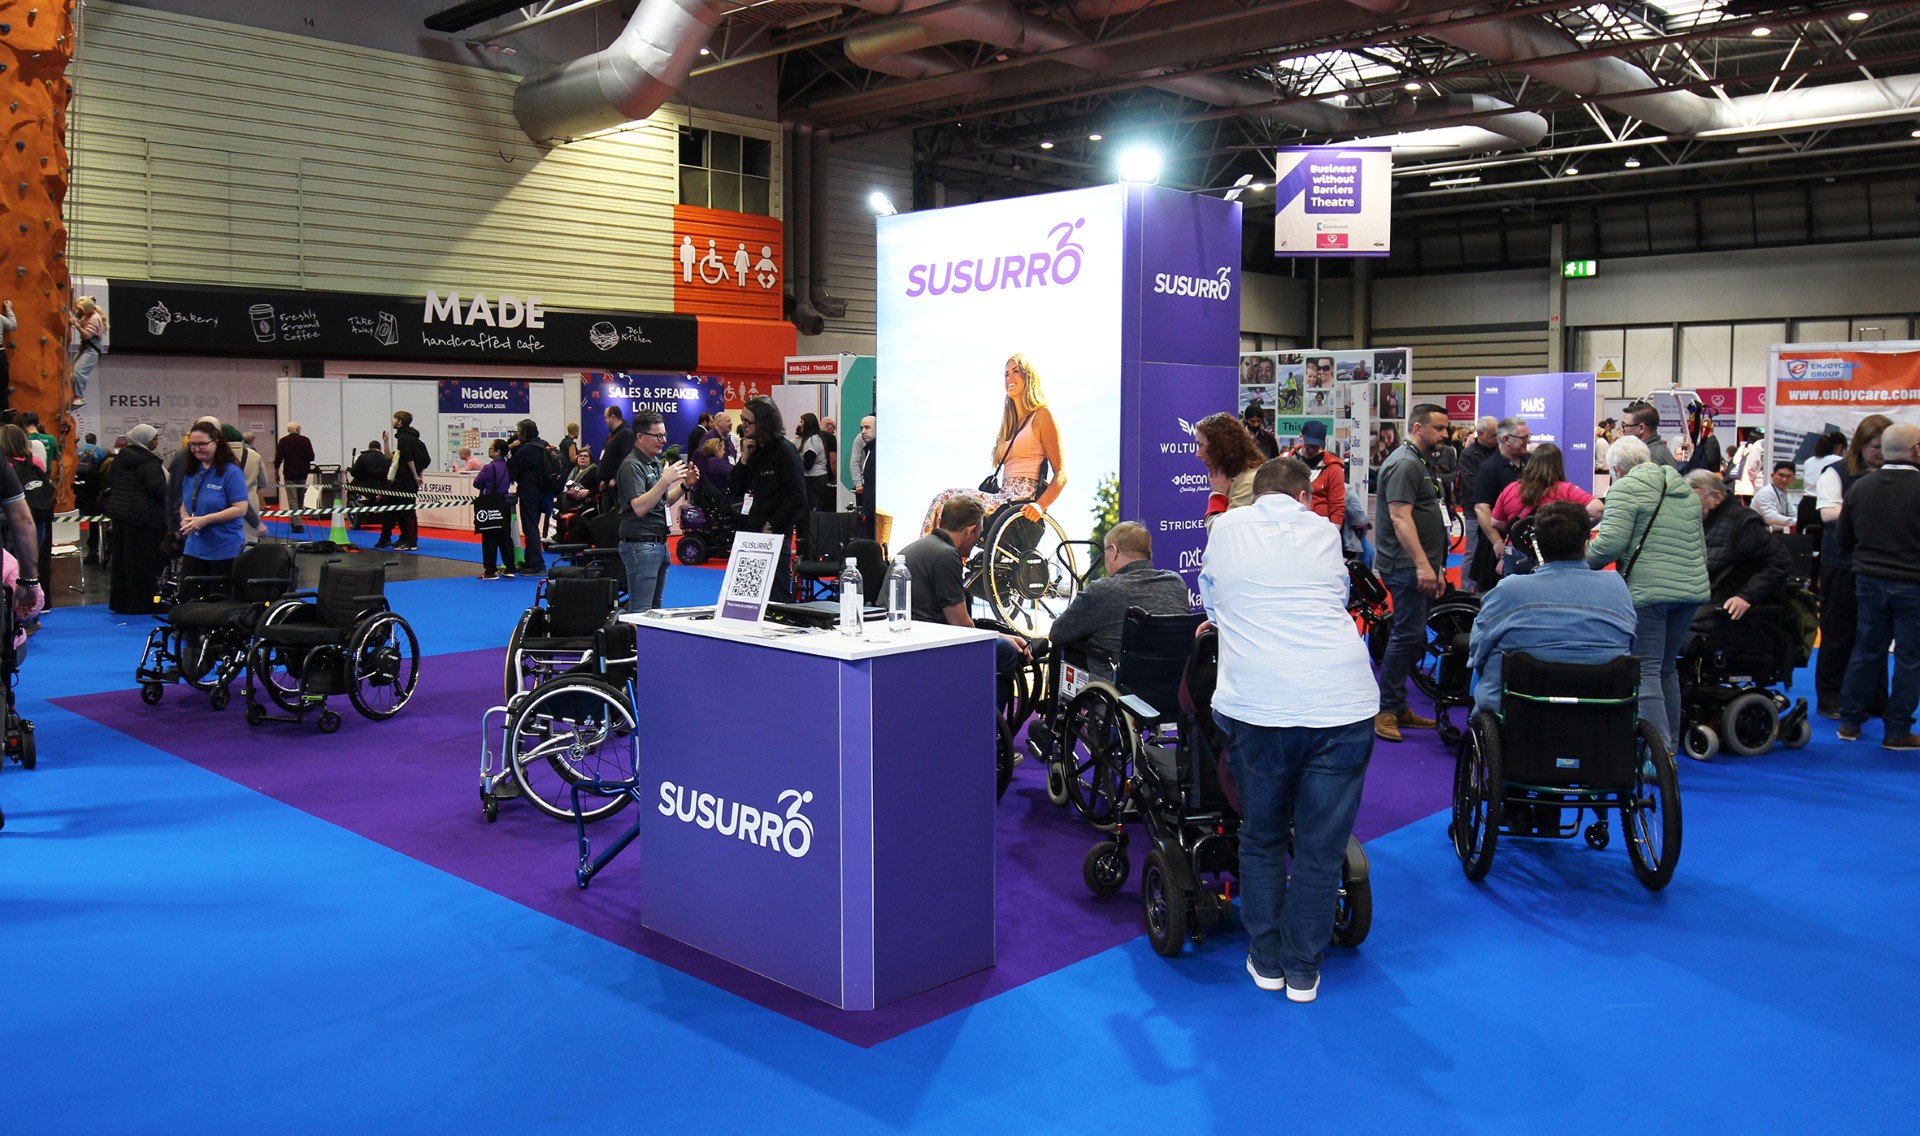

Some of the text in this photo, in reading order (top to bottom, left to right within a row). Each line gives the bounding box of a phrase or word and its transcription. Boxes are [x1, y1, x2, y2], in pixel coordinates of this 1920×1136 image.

[303, 17, 314, 27] 14
[1310, 164, 1357, 173] Business
[1312, 175, 1355, 183] without
[1313, 185, 1353, 194] Barriers
[1310, 197, 1355, 207] Theatre
[906, 243, 1083, 297] SUSURRO
[1154, 272, 1231, 301] SUSURRO
[280, 309, 316, 320] Freshly
[423, 290, 545, 329] MADE
[173, 312, 218, 328] Bakery
[281, 320, 320, 330] Ground
[348, 316, 374, 325] Take
[284, 330, 320, 341] Coffee
[352, 325, 373, 336] Away
[626, 326, 642, 334] Deli
[422, 331, 544, 351] handcrafted cafe
[622, 333, 651, 343] Kitchen
[461, 387, 508, 400] Naidex
[608, 387, 699, 399] SALES & SPEAKER
[1788, 388, 1920, 402] www.enjoycare.com
[110, 395, 218, 408] FRESH TO GO
[1521, 397, 1546, 412] MARS
[632, 402, 678, 413] LOUNGE
[1283, 422, 1301, 431] This
[1160, 443, 1199, 453] WOLTU
[1181, 473, 1207, 485] decon
[429, 485, 452, 493] SPEAKER
[741, 541, 773, 550] SUSURRO
[1180, 547, 1203, 568] nxt
[657, 781, 812, 858] SUSURRO
